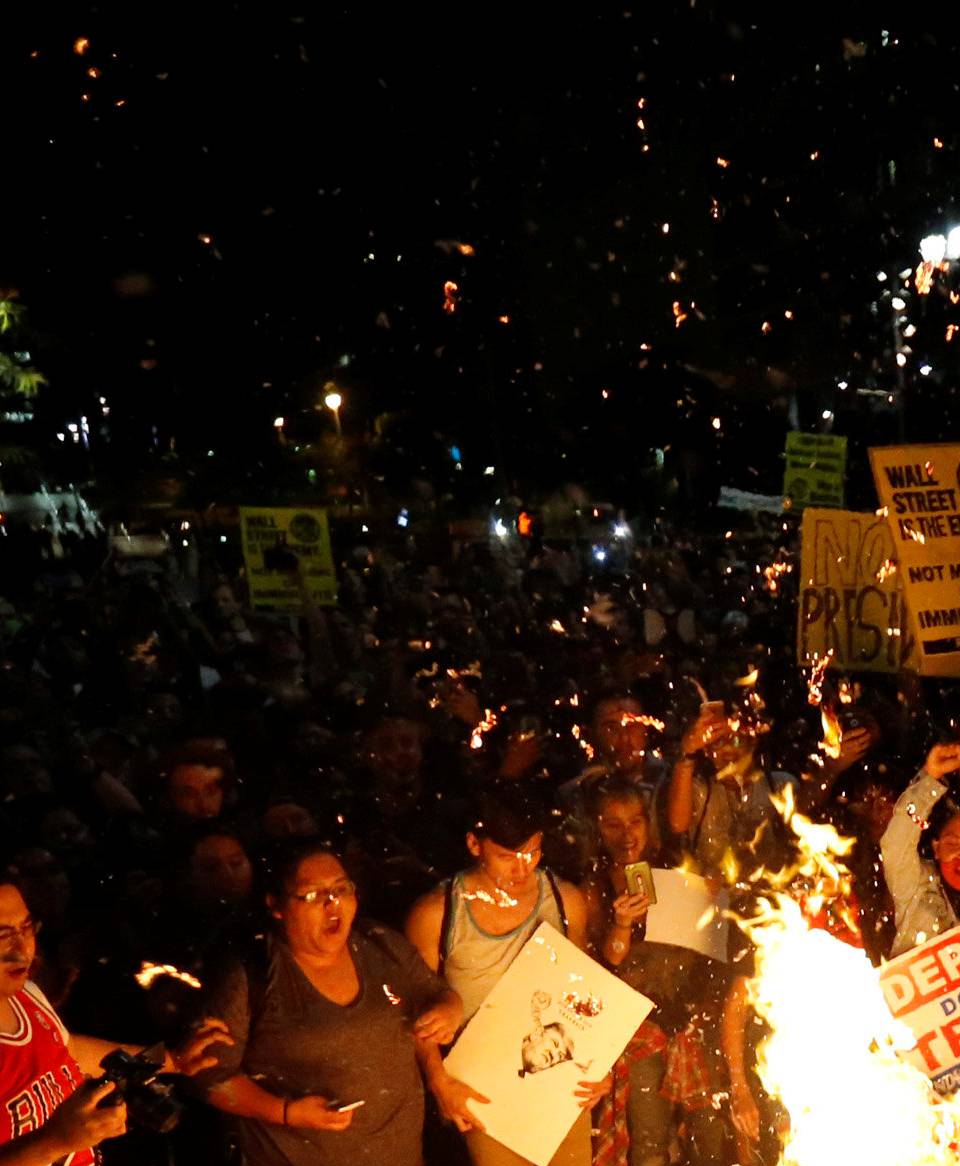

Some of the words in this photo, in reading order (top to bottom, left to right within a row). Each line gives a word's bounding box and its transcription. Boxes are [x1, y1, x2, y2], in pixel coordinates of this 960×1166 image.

[883, 463, 939, 489] WALL
[893, 489, 957, 514] STREET
[919, 515, 947, 538] THE
[909, 565, 945, 584] NOT
